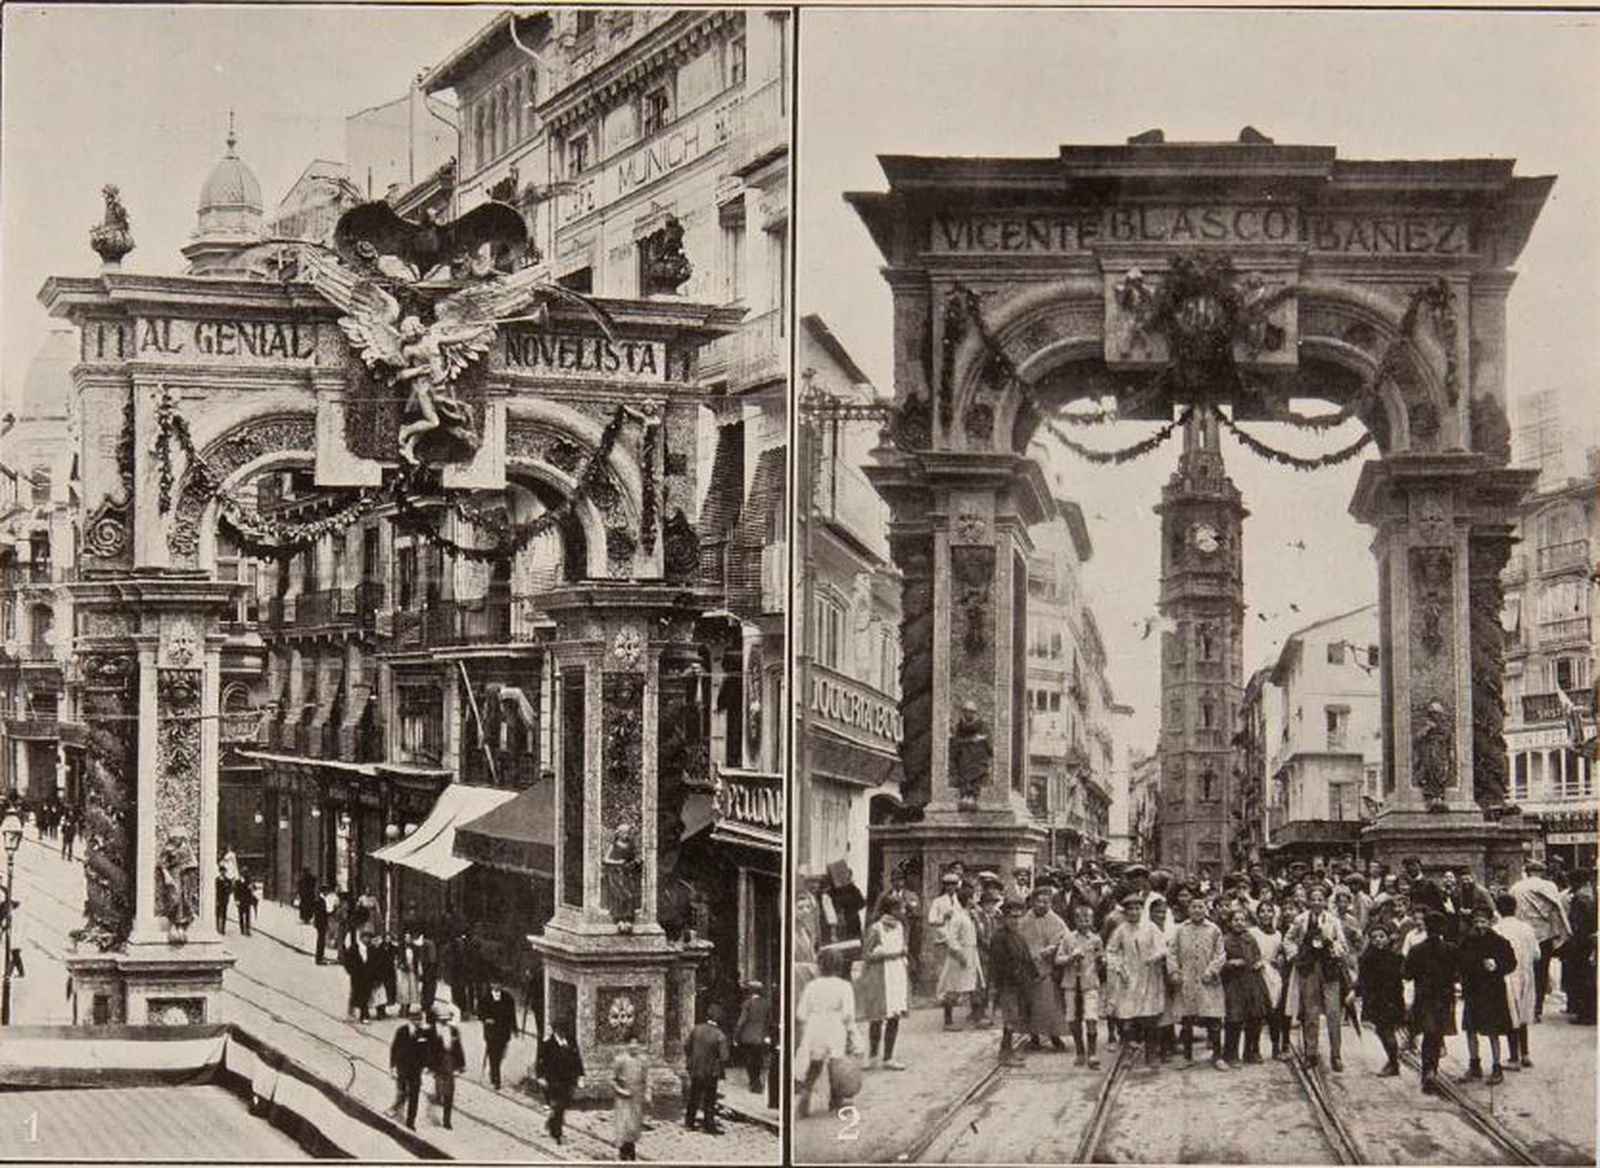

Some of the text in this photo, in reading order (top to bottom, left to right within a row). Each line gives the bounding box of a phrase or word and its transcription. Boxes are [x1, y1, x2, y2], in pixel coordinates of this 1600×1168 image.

[618, 124, 699, 194] MUNICH
[934, 213, 1100, 251] VICENTE
[1110, 204, 1291, 241] BLASCO
[141, 317, 658, 376] AL GENIAL NOVELISTA
